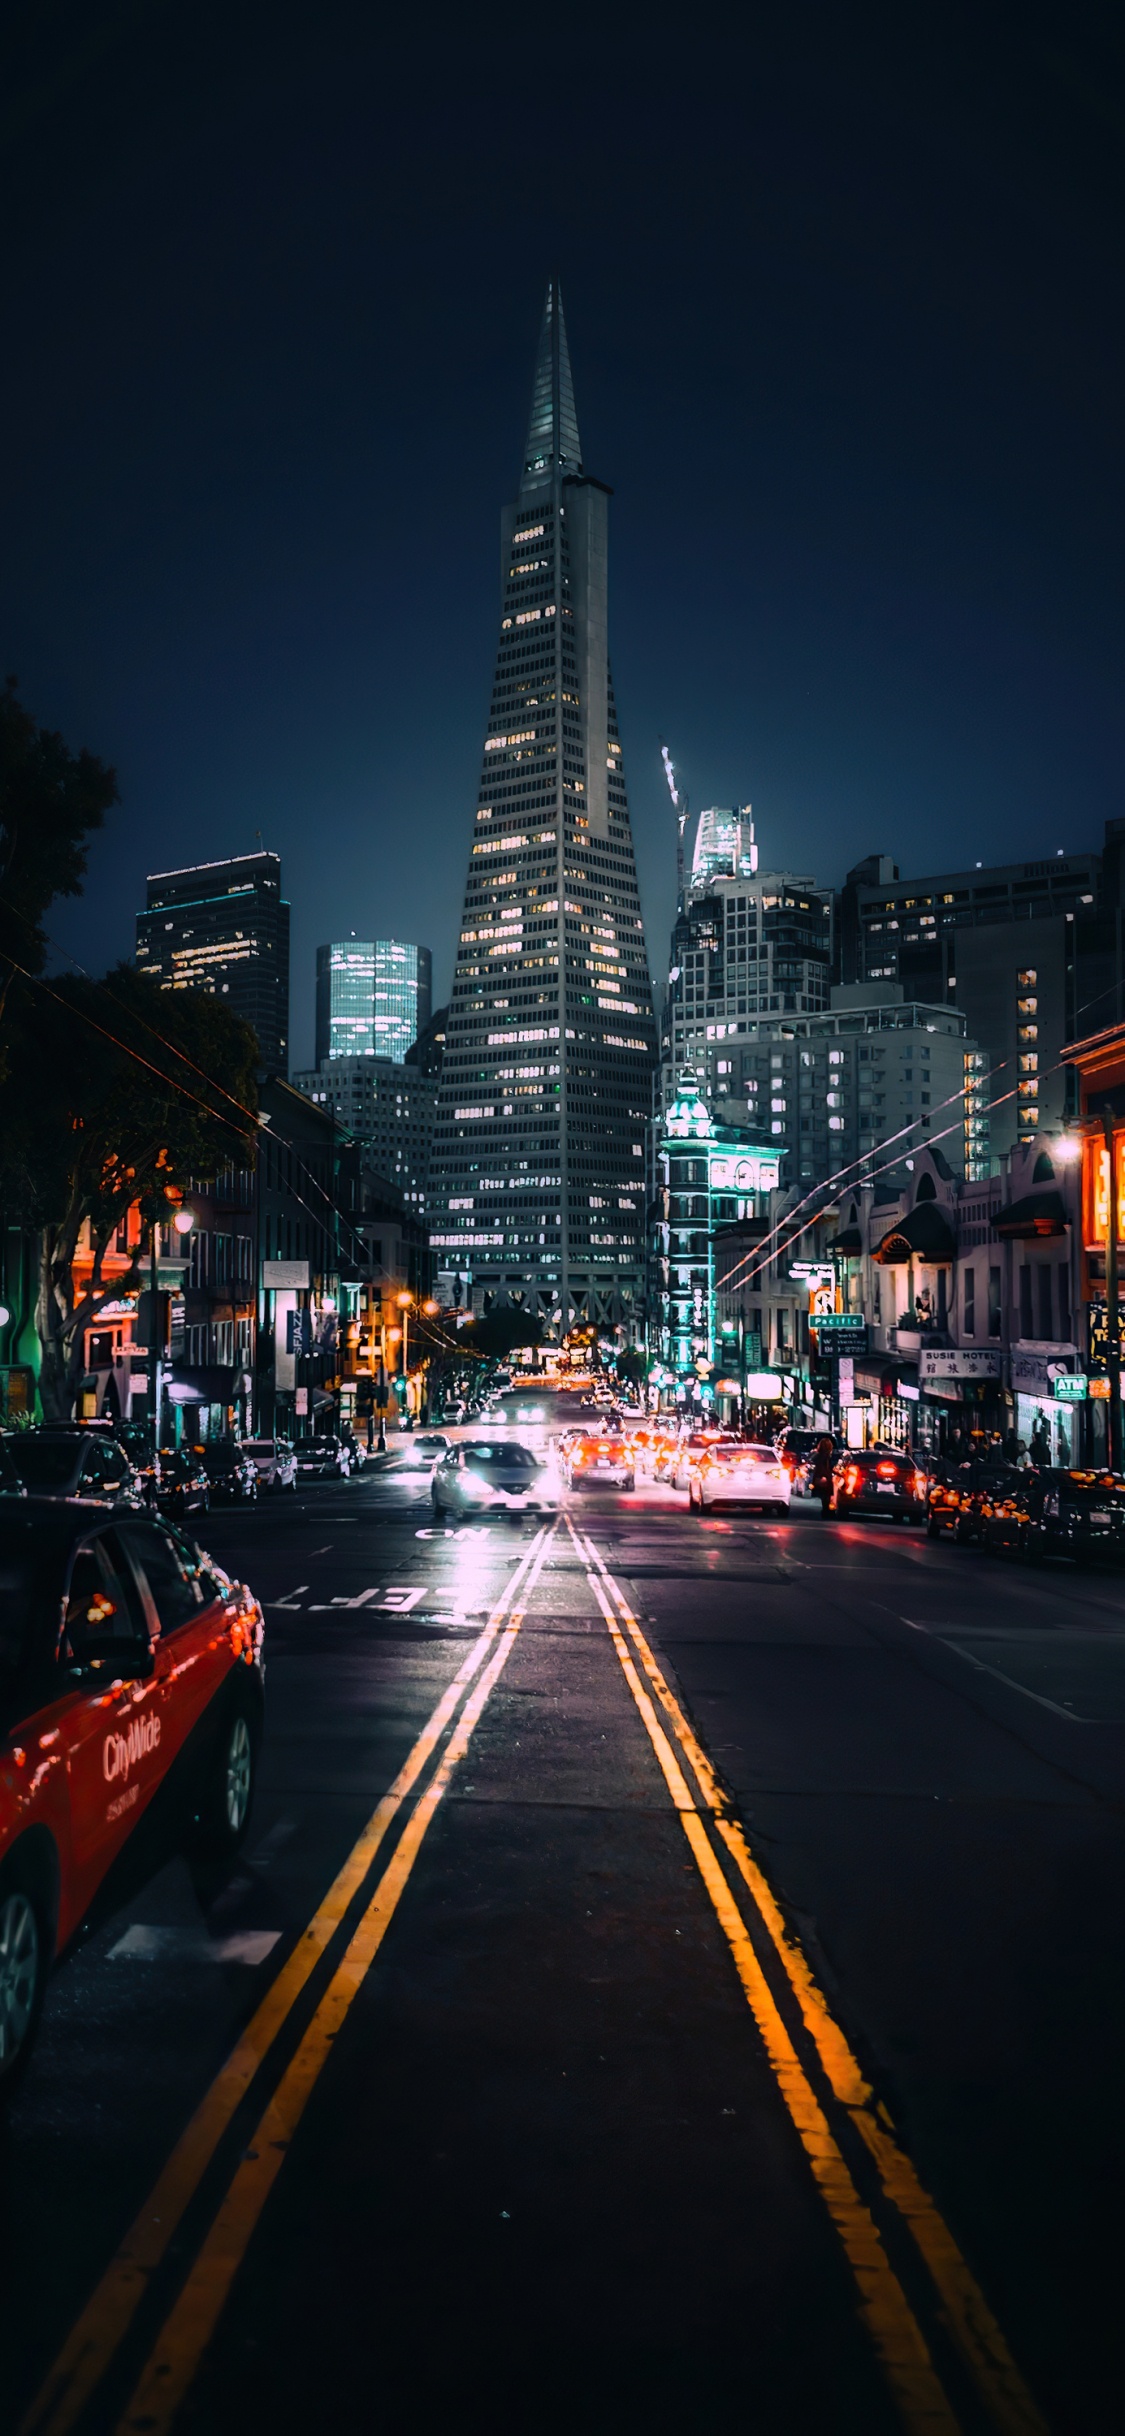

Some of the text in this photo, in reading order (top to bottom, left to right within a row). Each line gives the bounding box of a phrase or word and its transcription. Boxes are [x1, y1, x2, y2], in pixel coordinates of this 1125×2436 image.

[1024, 863, 1070, 878] Hilton
[814, 1316, 858, 1326] Pacific
[293, 1309, 303, 1356] SFJAZZ
[926, 1352, 996, 1360] SUSIE HOTEL
[1057, 1378, 1085, 1391] ATM
[103, 1708, 162, 1783] CityWide
